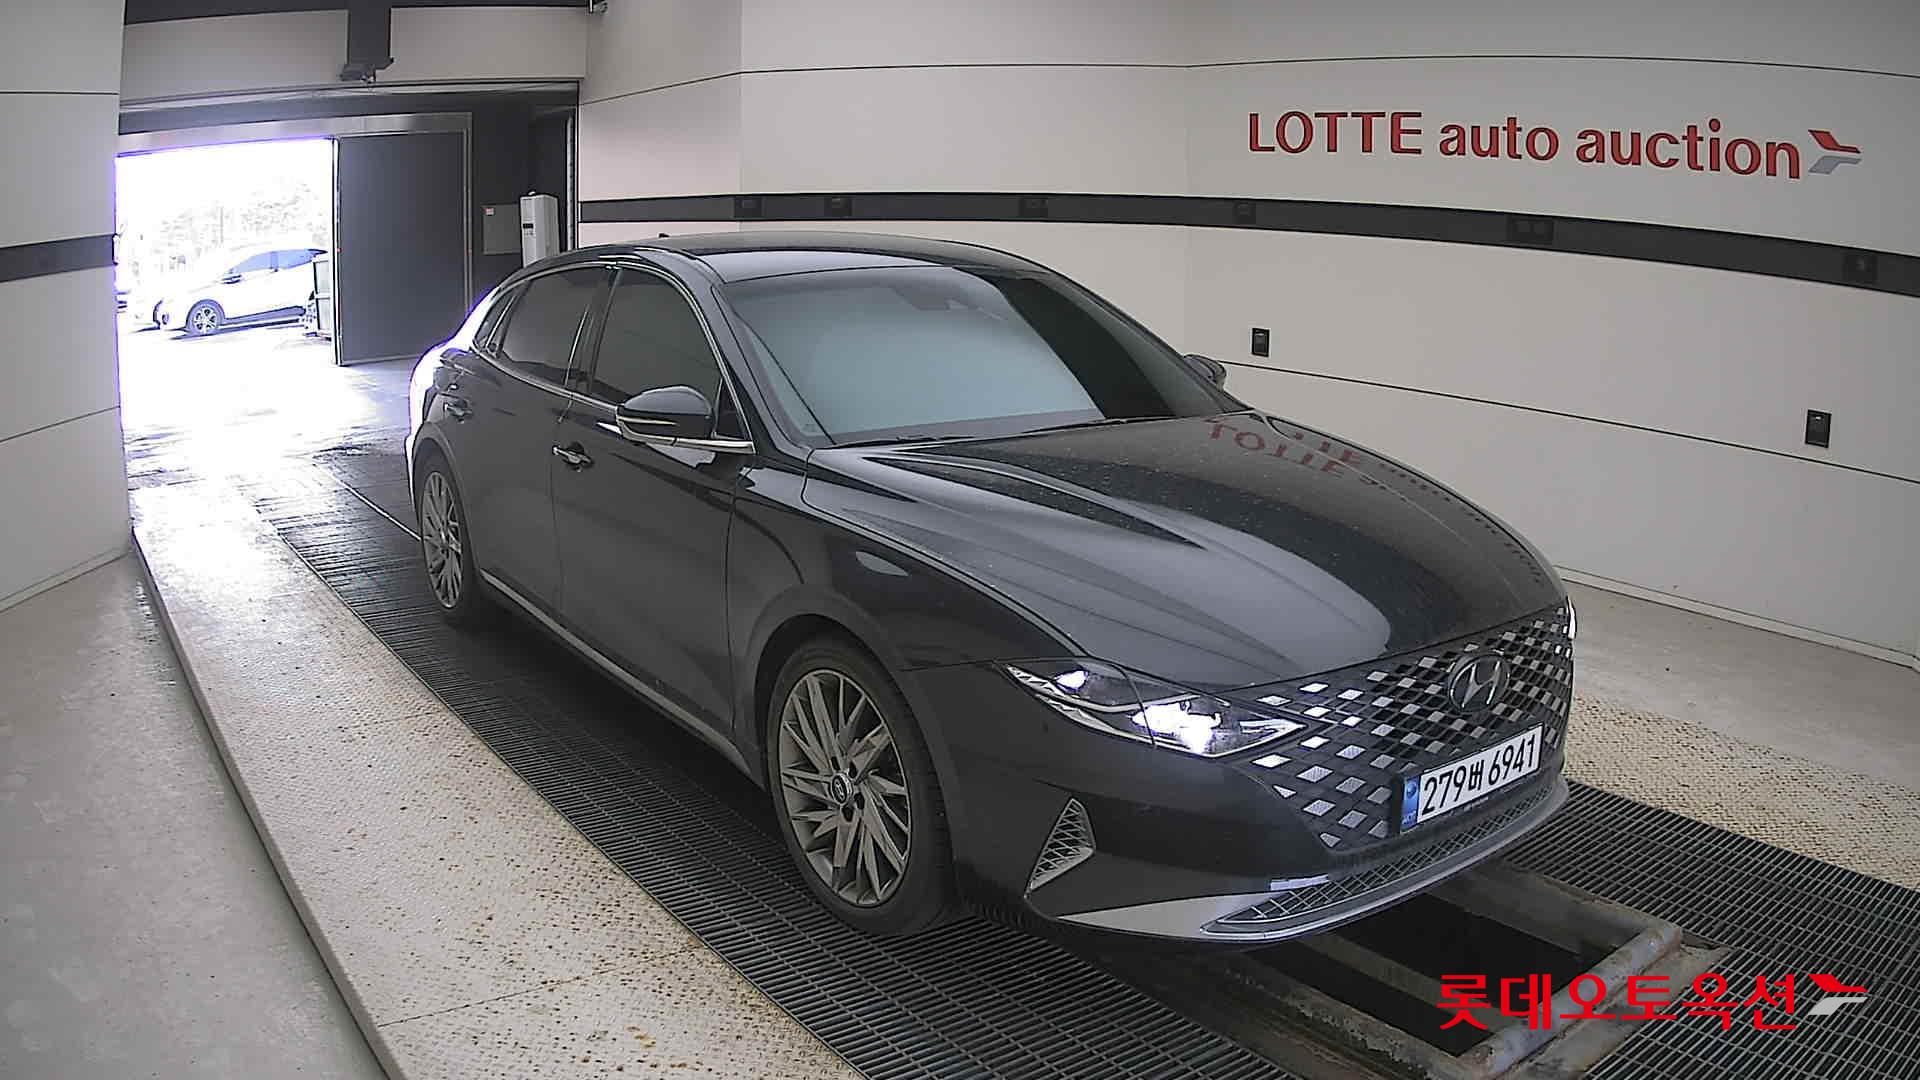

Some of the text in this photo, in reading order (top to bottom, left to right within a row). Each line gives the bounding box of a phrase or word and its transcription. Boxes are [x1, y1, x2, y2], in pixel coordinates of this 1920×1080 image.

[1248, 111, 1800, 179] LOTTE auto auction
[1422, 734, 1536, 815] 279버 6941
